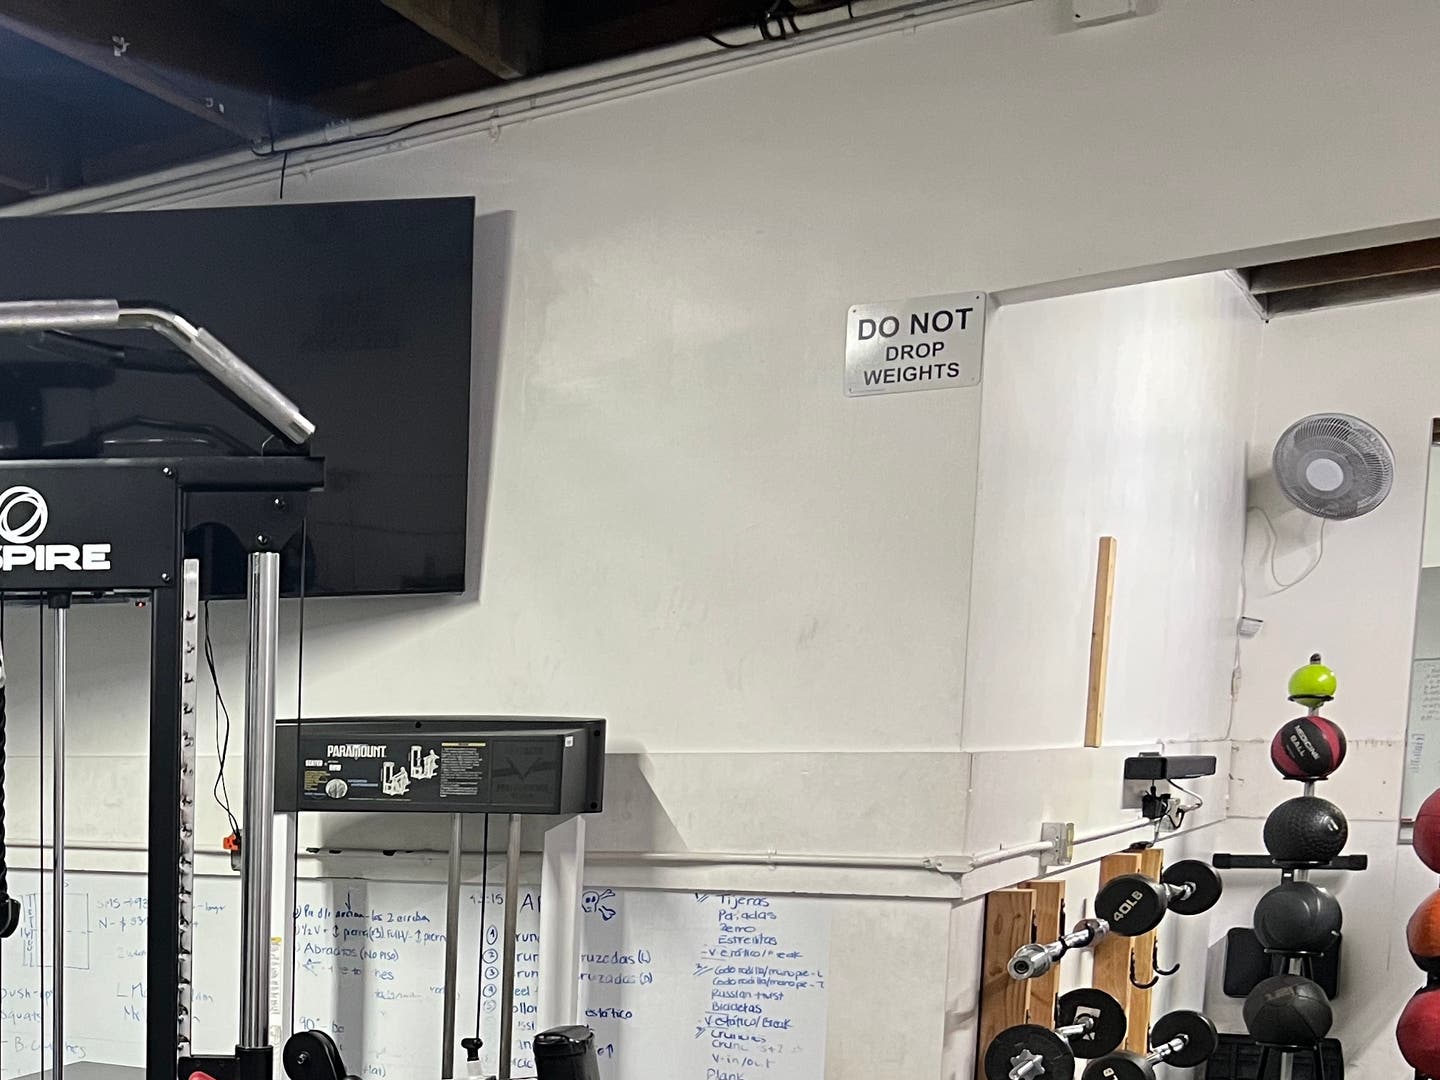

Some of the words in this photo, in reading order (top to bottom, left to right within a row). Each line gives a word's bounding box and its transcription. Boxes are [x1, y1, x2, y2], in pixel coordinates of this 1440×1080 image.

[858, 316, 900, 340] DO
[910, 308, 973, 335] NOT
[886, 341, 945, 361] DROP
[864, 362, 960, 385] WEIGHTS
[327, 744, 387, 759] PARAMOUNT
[1290, 734, 1307, 757] BALL
[1294, 725, 1321, 760] MEDICINE
[1113, 890, 1143, 922] 40LB
[581, 951, 635, 965] ruzadas
